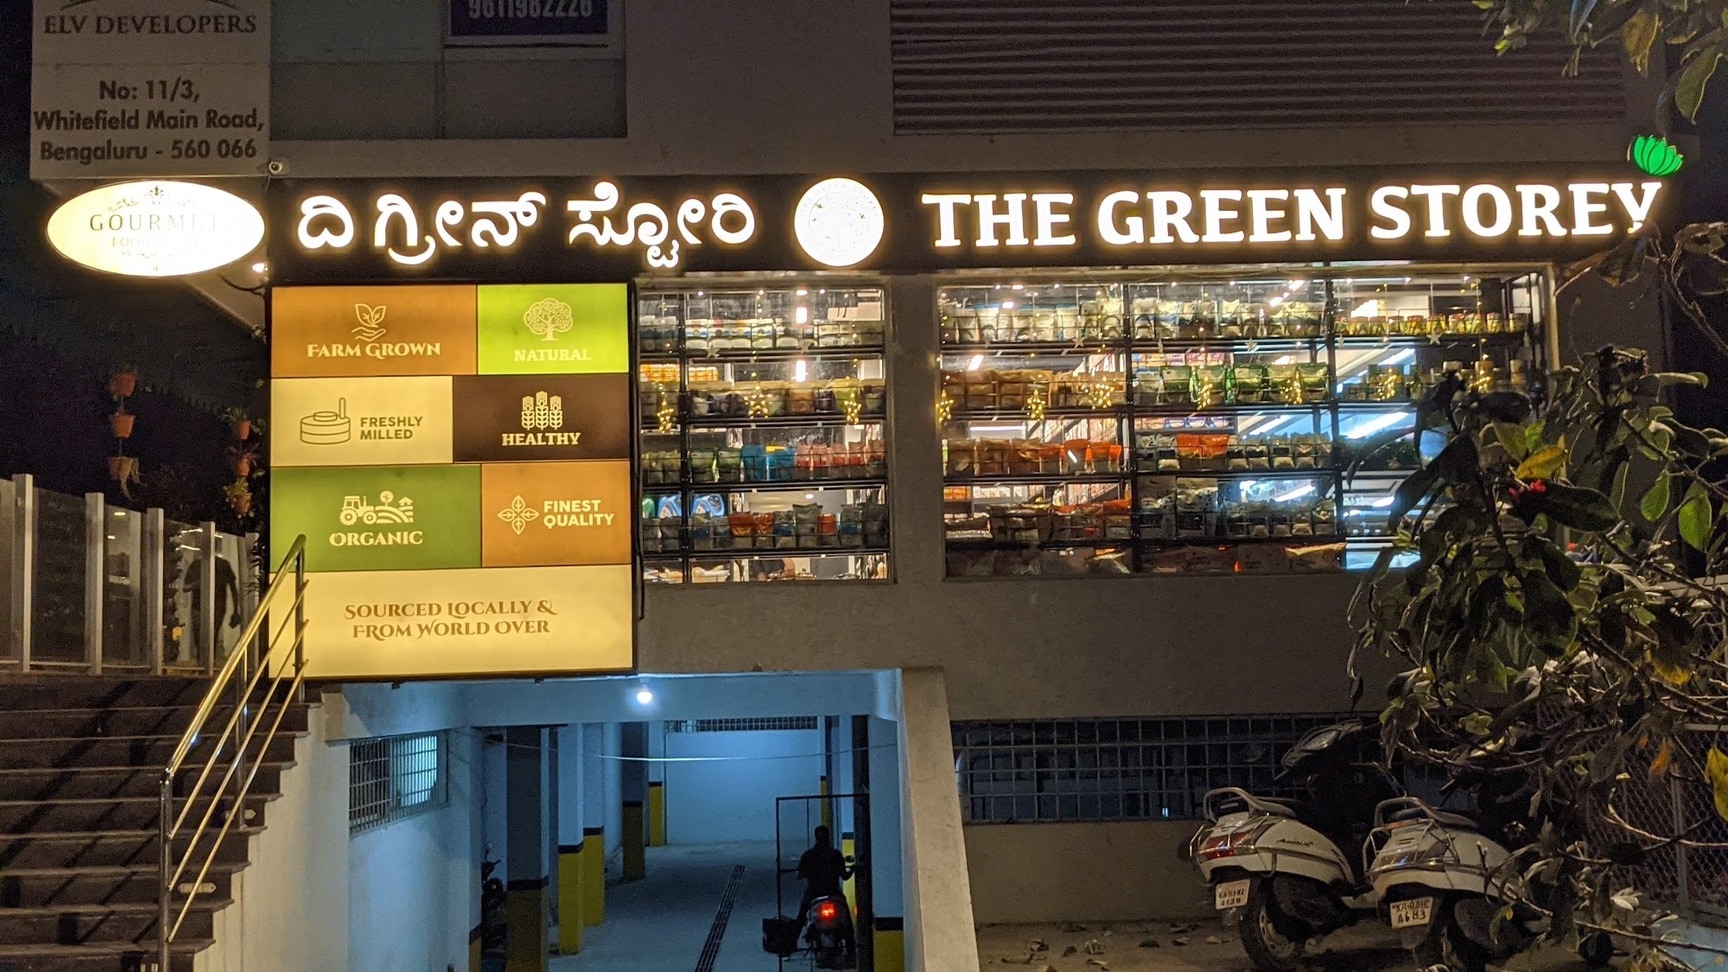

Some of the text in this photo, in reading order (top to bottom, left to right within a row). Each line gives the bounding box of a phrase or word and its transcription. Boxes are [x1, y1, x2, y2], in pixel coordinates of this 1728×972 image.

[44, 14, 257, 34] ELV DEVELOPERS
[99, 77, 200, 103] No: 11/3,
[34, 108, 264, 131] Whitefield Main Road,
[40, 140, 147, 165] Bengaluru
[171, 140, 210, 159] 560
[217, 139, 257, 158] 066
[921, 192, 1076, 249] THE
[1096, 187, 1348, 246] GREEN
[1369, 181, 1663, 240] STOREY
[299, 194, 355, 250] ದಿ
[373, 191, 547, 266] ಗ್ರೀನ್
[567, 181, 756, 268] ಸ್ಟೋರಿ
[307, 342, 441, 359] FARM GROWN
[514, 349, 592, 362] NATURAL
[360, 416, 423, 428] FRESHLY
[360, 429, 413, 441] MILLED
[501, 432, 581, 446] HEALTHY
[543, 500, 601, 514] FINEST
[543, 513, 615, 529] QUALITY
[329, 530, 423, 546] ORGANIC
[344, 599, 558, 620] SOURCED LOCALLY &
[352, 619, 550, 641] FROM WORLD OVER
